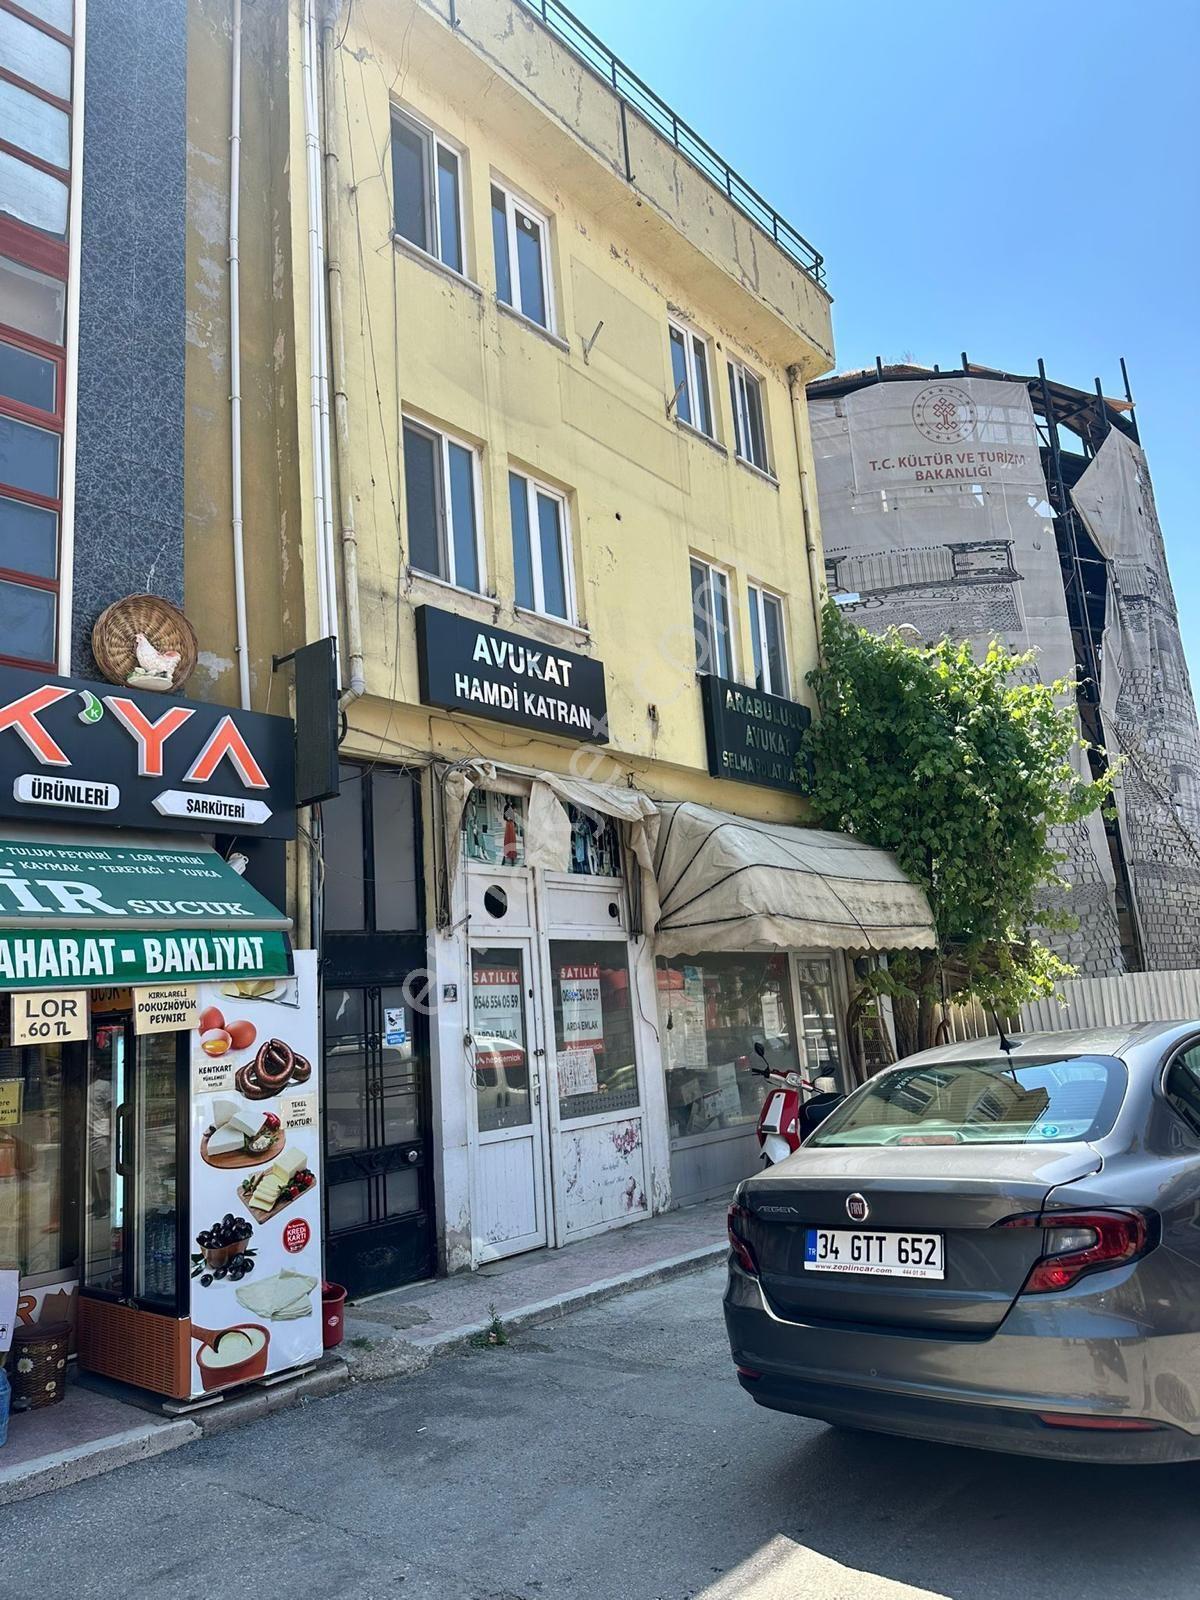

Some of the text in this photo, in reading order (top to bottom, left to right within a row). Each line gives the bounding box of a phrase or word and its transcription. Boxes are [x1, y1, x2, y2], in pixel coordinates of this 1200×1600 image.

[868, 449, 1026, 472] T.C. KÜLTÜR VE TURİZM
[915, 463, 992, 481] BAKANLIĞI
[851, 550, 886, 560] metal
[472, 633, 573, 688] AVUKAT
[454, 672, 592, 730] HAMDİ KATRAN
[745, 724, 791, 757] AVUKAT
[722, 750, 755, 774] SELMA
[31, 778, 109, 806] ÜRÜNLERİ
[186, 798, 245, 818] ŞARKÜTERİ
[6, 846, 205, 866] TULUM PEYNİRİ LOR PEYNİRİ
[19, 861, 222, 879] KAYMAK TEREYAĞI YUFKA
[127, 899, 255, 916] SUCUK
[143, 936, 264, 974] BAKLİYAT
[473, 971, 519, 984] SATILIK
[560, 966, 599, 979] SATILIK
[148, 988, 187, 999] KIRKLARELİ
[473, 995, 490, 1010] 0546
[502, 995, 511, 1009] 05
[511, 994, 519, 1008] 59
[592, 988, 599, 1001] 59
[26, 999, 78, 1018] LOR
[138, 998, 197, 1013] DOKUZHÖYÜK
[28, 1022, 51, 1037] 60
[54, 1021, 72, 1036] TL
[495, 1028, 518, 1040] EMLAK
[566, 1020, 599, 1032] ARDA EMLAK
[198, 1064, 233, 1075] KENTKART
[849, 1202, 864, 1215] FIAT
[808, 1248, 816, 1256] TR
[818, 1233, 937, 1266] 34 GTT 652
